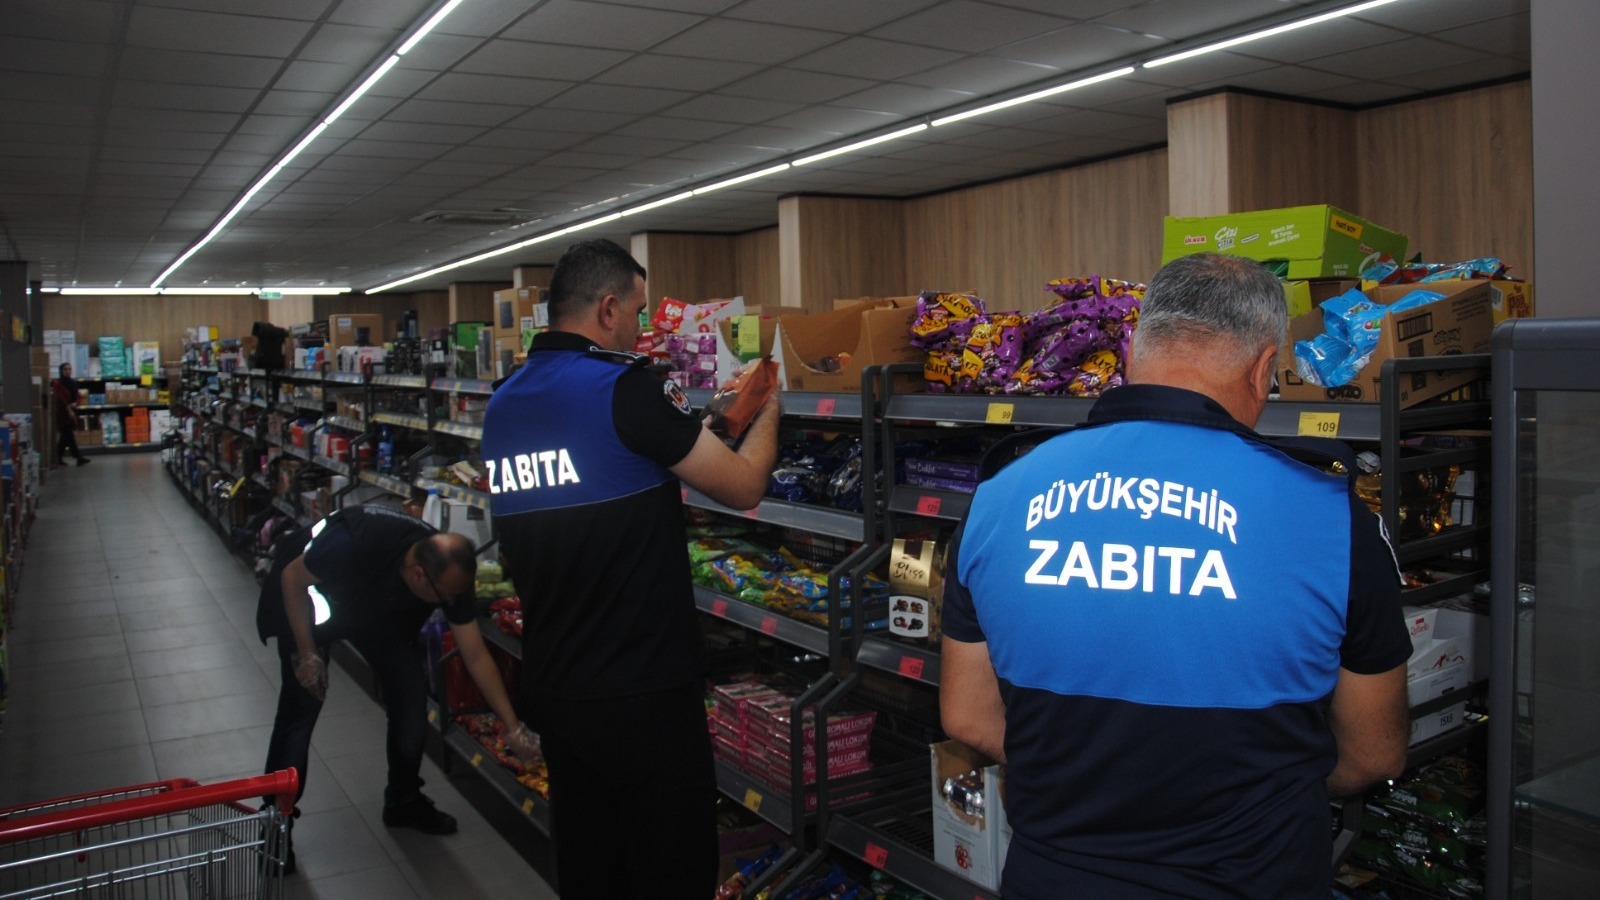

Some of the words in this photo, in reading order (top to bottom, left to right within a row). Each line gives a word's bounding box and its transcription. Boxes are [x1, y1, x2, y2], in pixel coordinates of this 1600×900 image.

[1001, 411, 1011, 419] 99
[1316, 421, 1336, 433] 109
[485, 447, 581, 495] ZABITA
[1025, 471, 1238, 545] BÜYÜKŞEHİR
[1024, 539, 1238, 600] ZABITA
